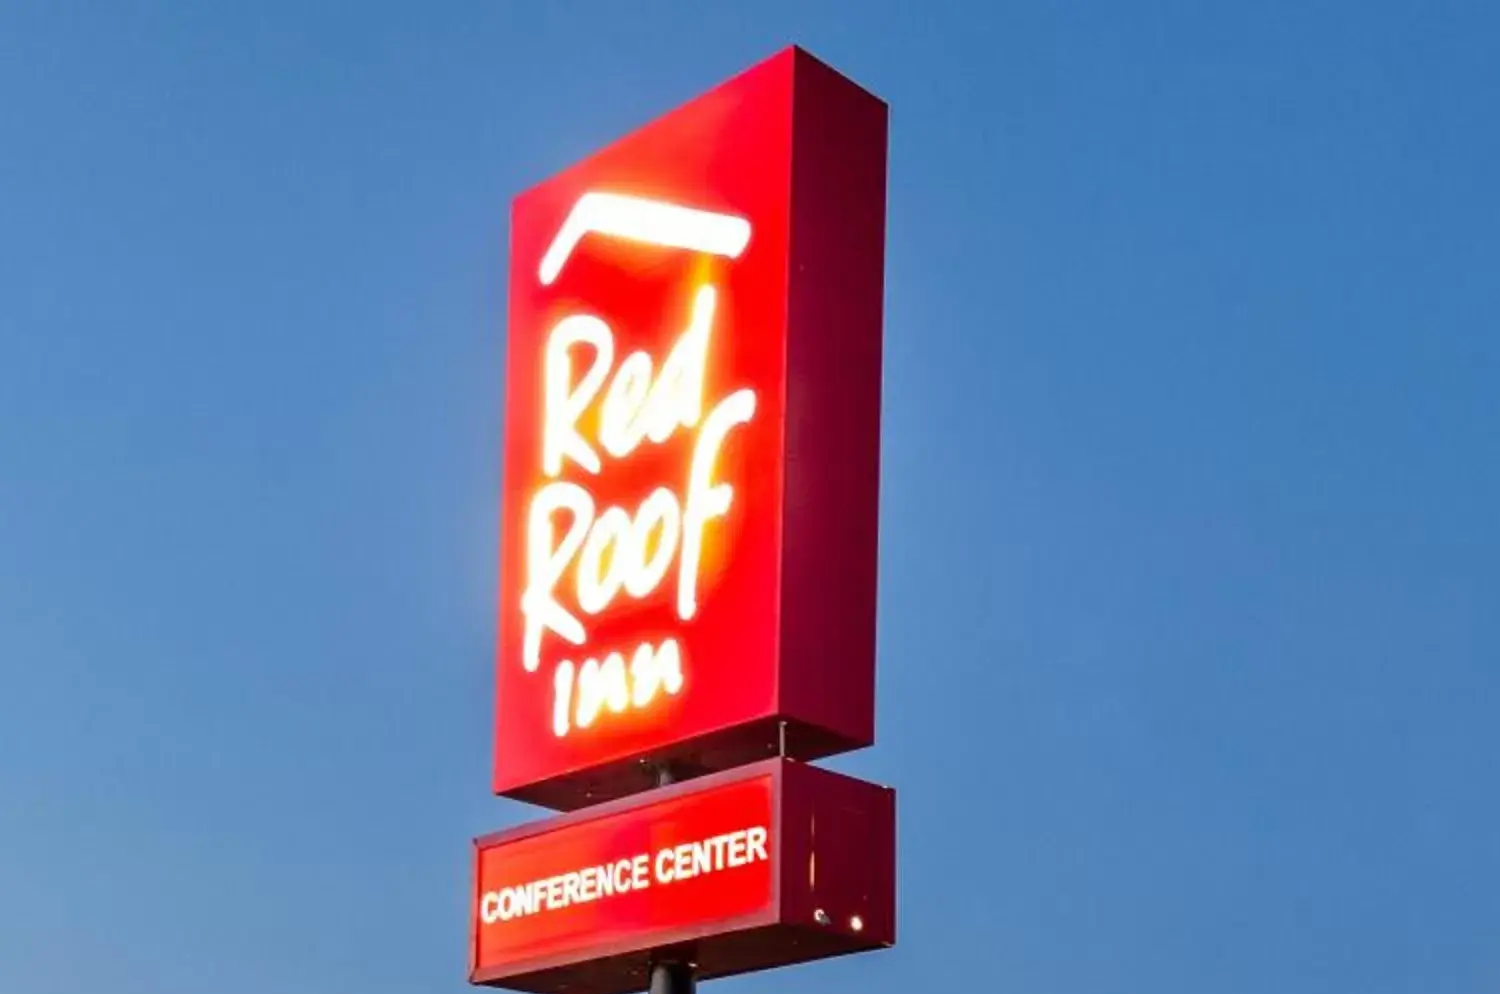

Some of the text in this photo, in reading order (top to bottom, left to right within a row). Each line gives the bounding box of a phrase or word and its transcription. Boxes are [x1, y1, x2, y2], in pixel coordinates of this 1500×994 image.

[544, 284, 716, 478] Red
[521, 389, 756, 672] Roof
[481, 826, 768, 924] CONFERENCE CENTER
